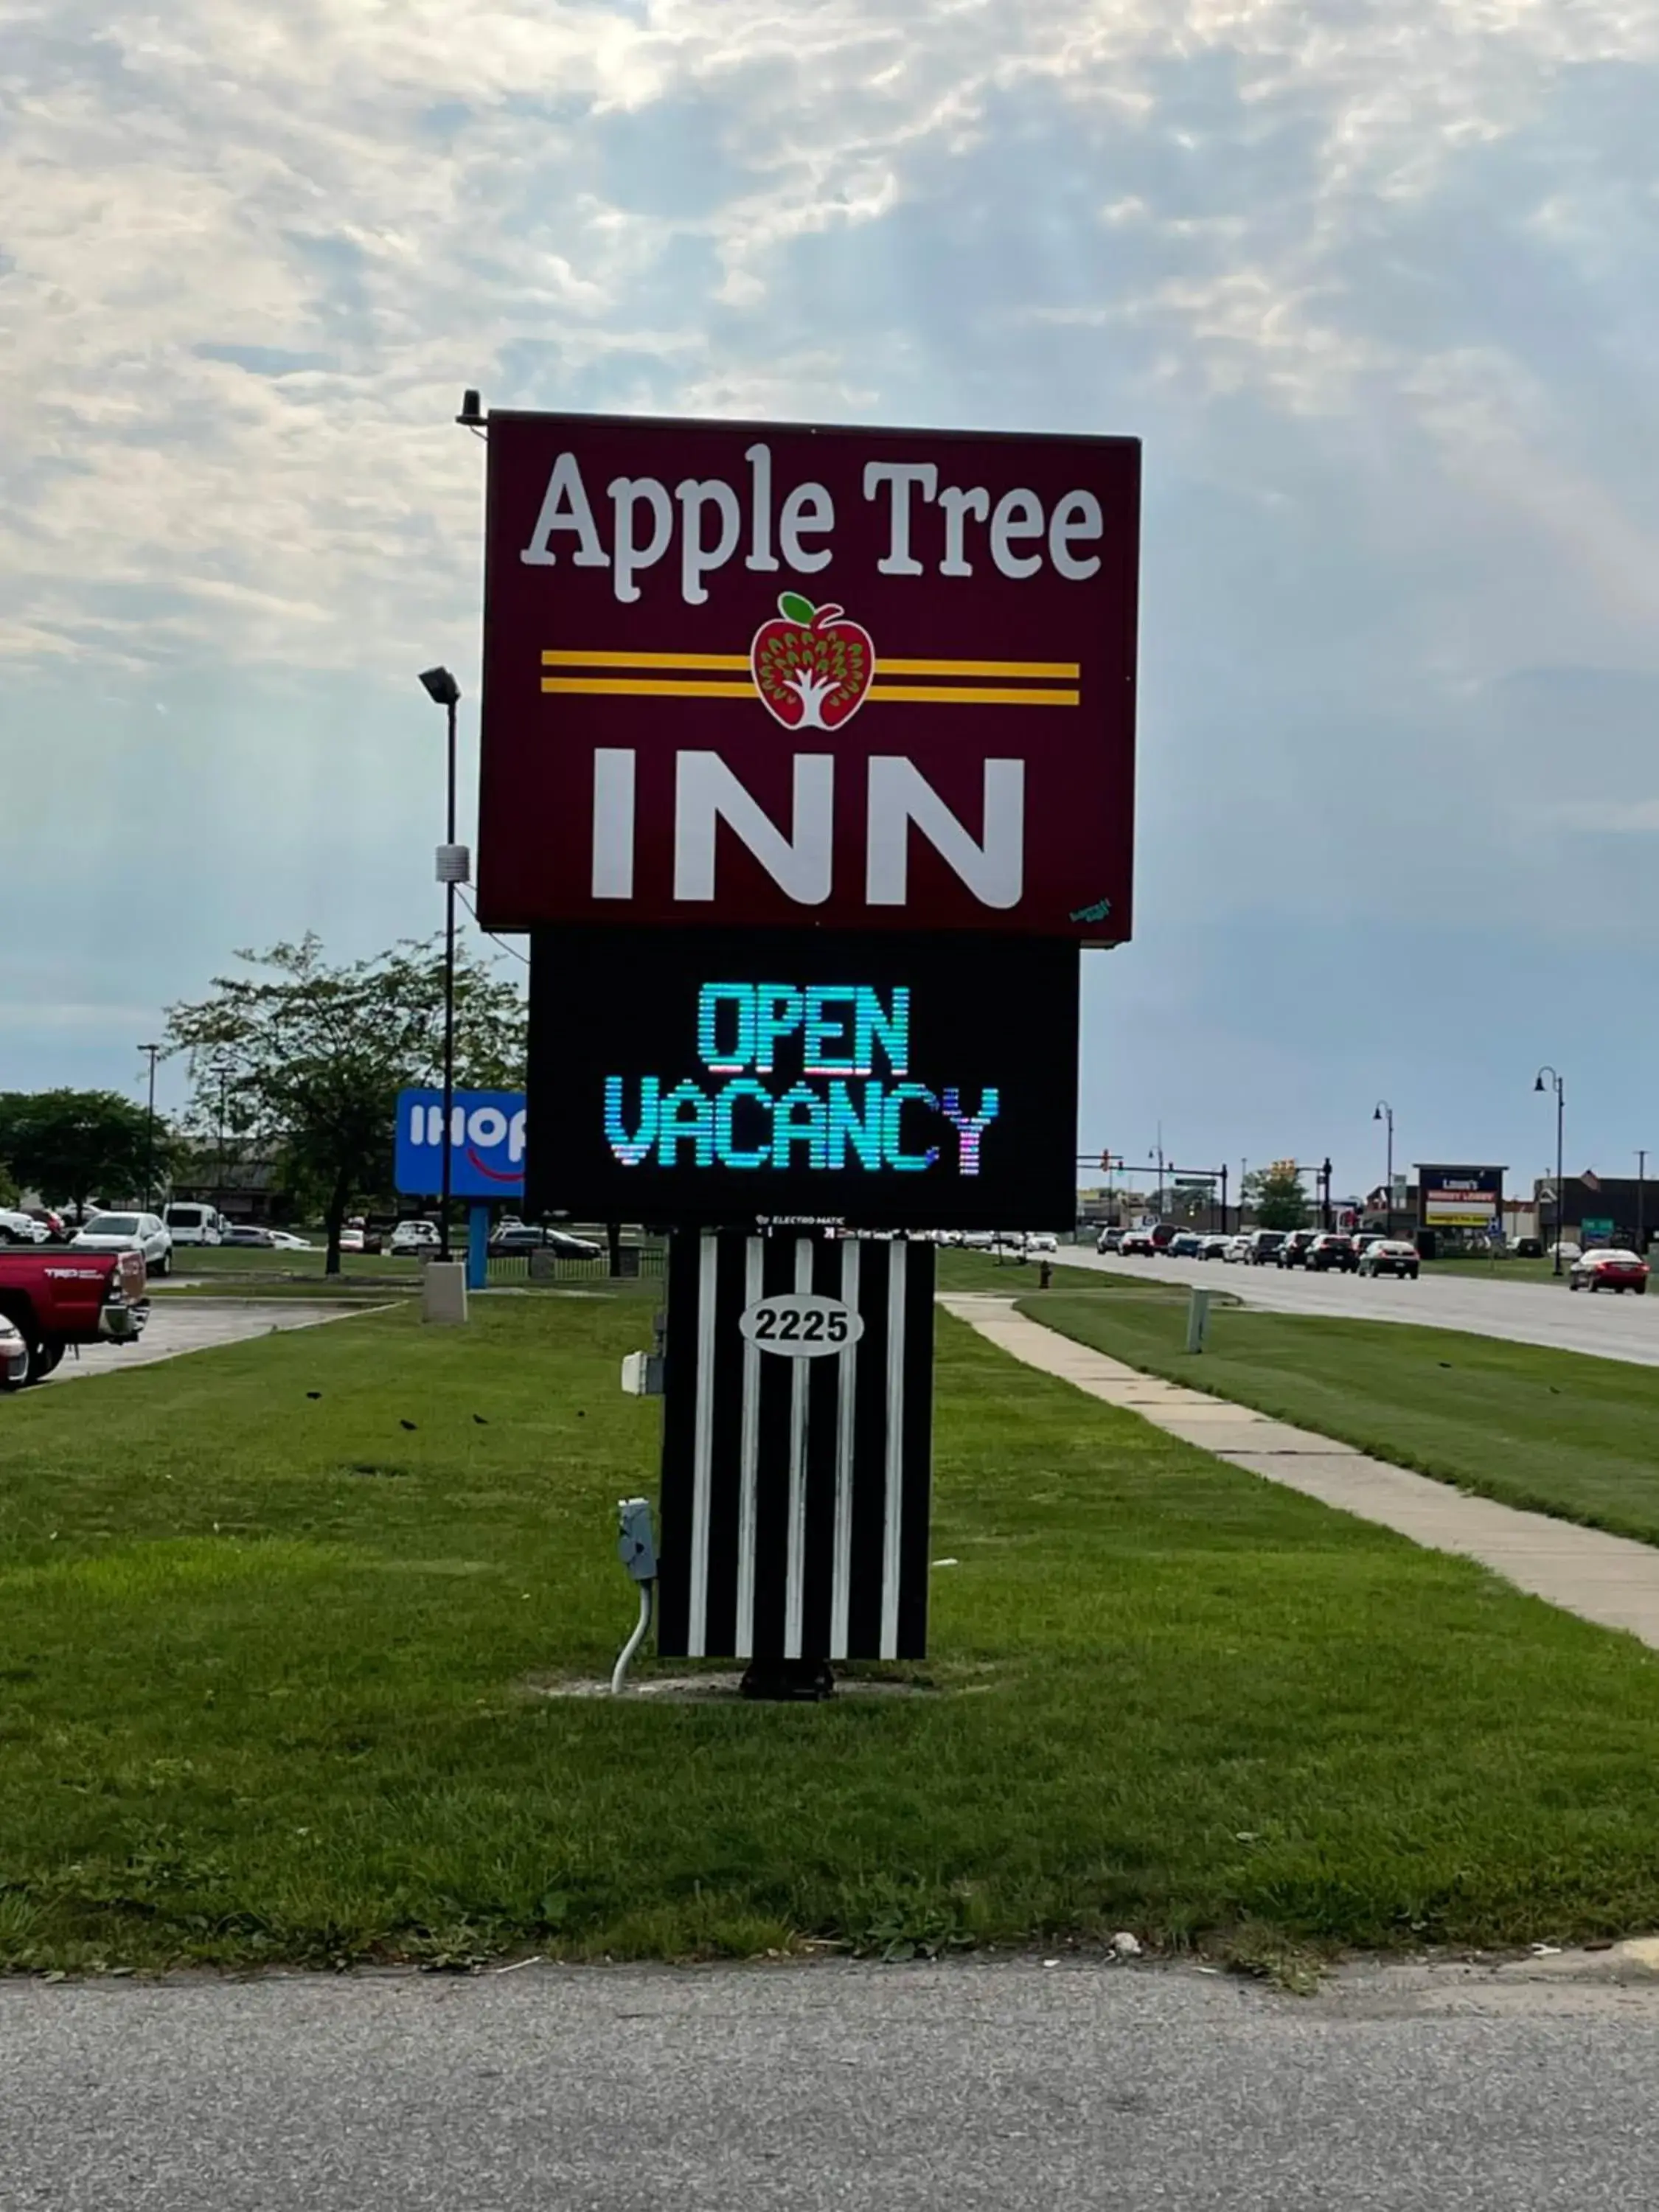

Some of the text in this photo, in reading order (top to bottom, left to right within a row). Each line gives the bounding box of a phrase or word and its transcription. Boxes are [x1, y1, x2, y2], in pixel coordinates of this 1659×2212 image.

[521, 443, 1103, 605] Apple Tree
[591, 747, 1026, 910] INN
[698, 982, 910, 1076] OPEN
[603, 1076, 999, 1175] VACANCY
[754, 1308, 848, 1342] 2225
